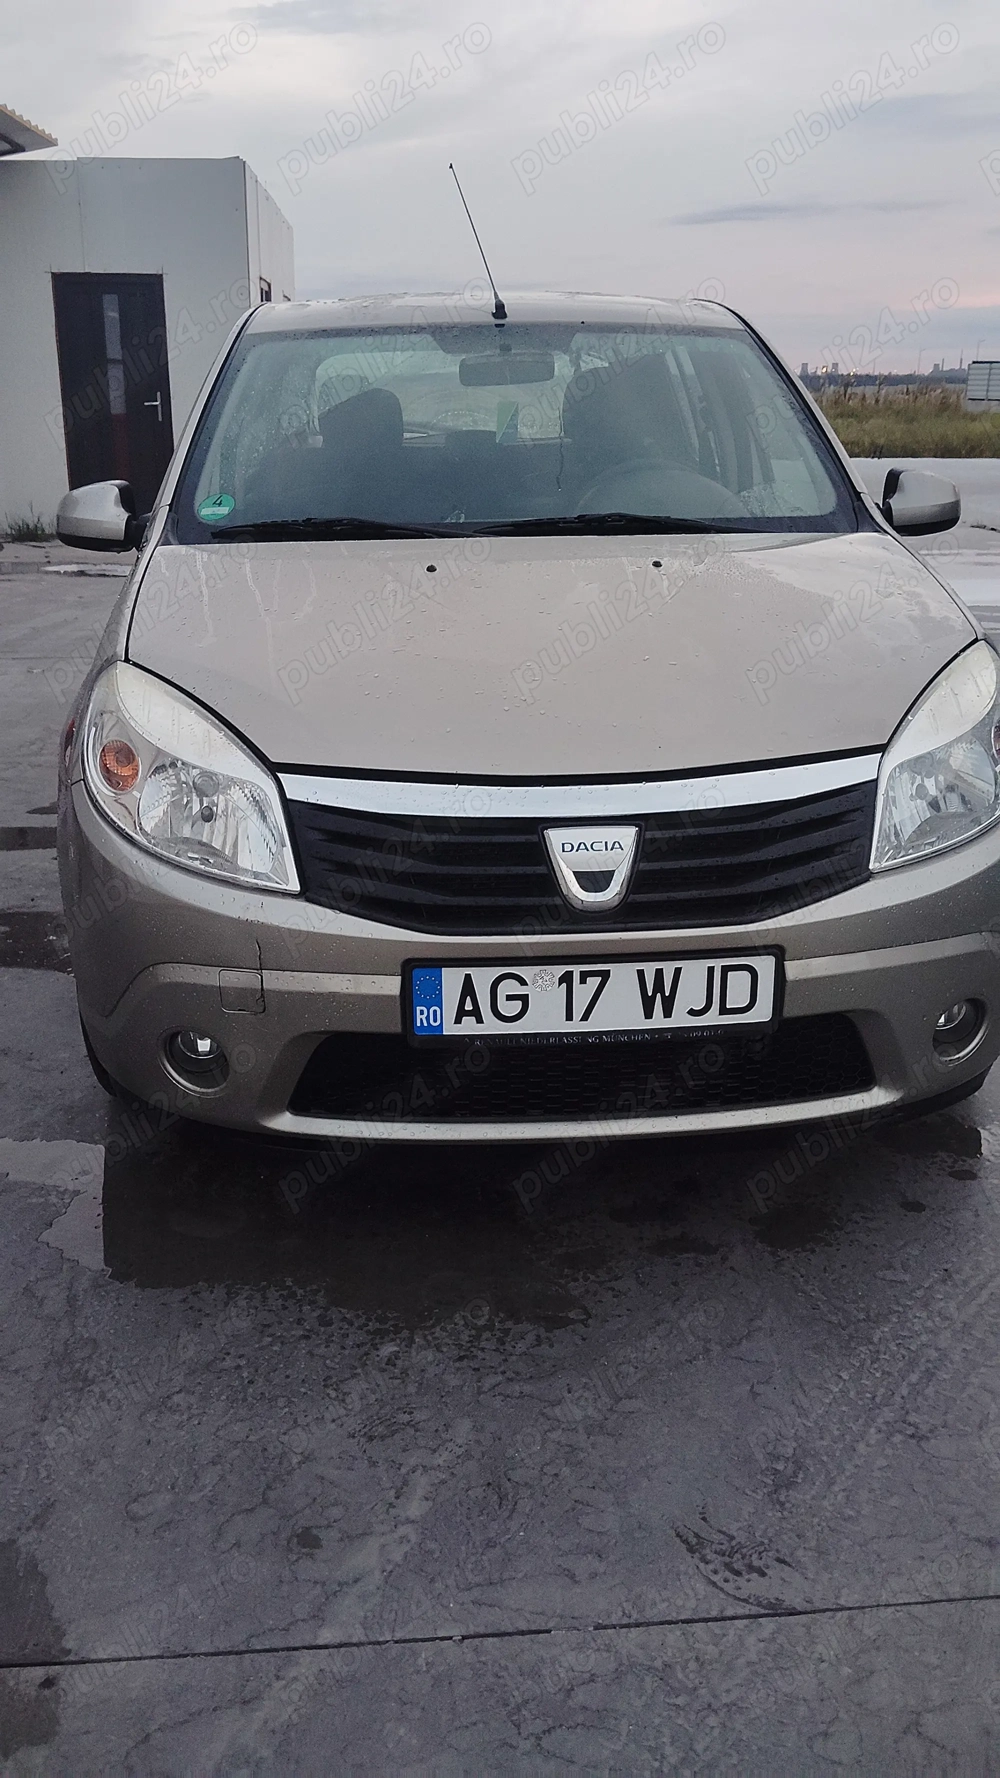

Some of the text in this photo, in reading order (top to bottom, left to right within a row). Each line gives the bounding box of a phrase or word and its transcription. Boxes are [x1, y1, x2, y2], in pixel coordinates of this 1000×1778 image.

[212, 494, 223, 507] 4
[561, 840, 624, 853] DACIA
[453, 963, 758, 1024] AG 17 WJD
[416, 1006, 441, 1027] RO
